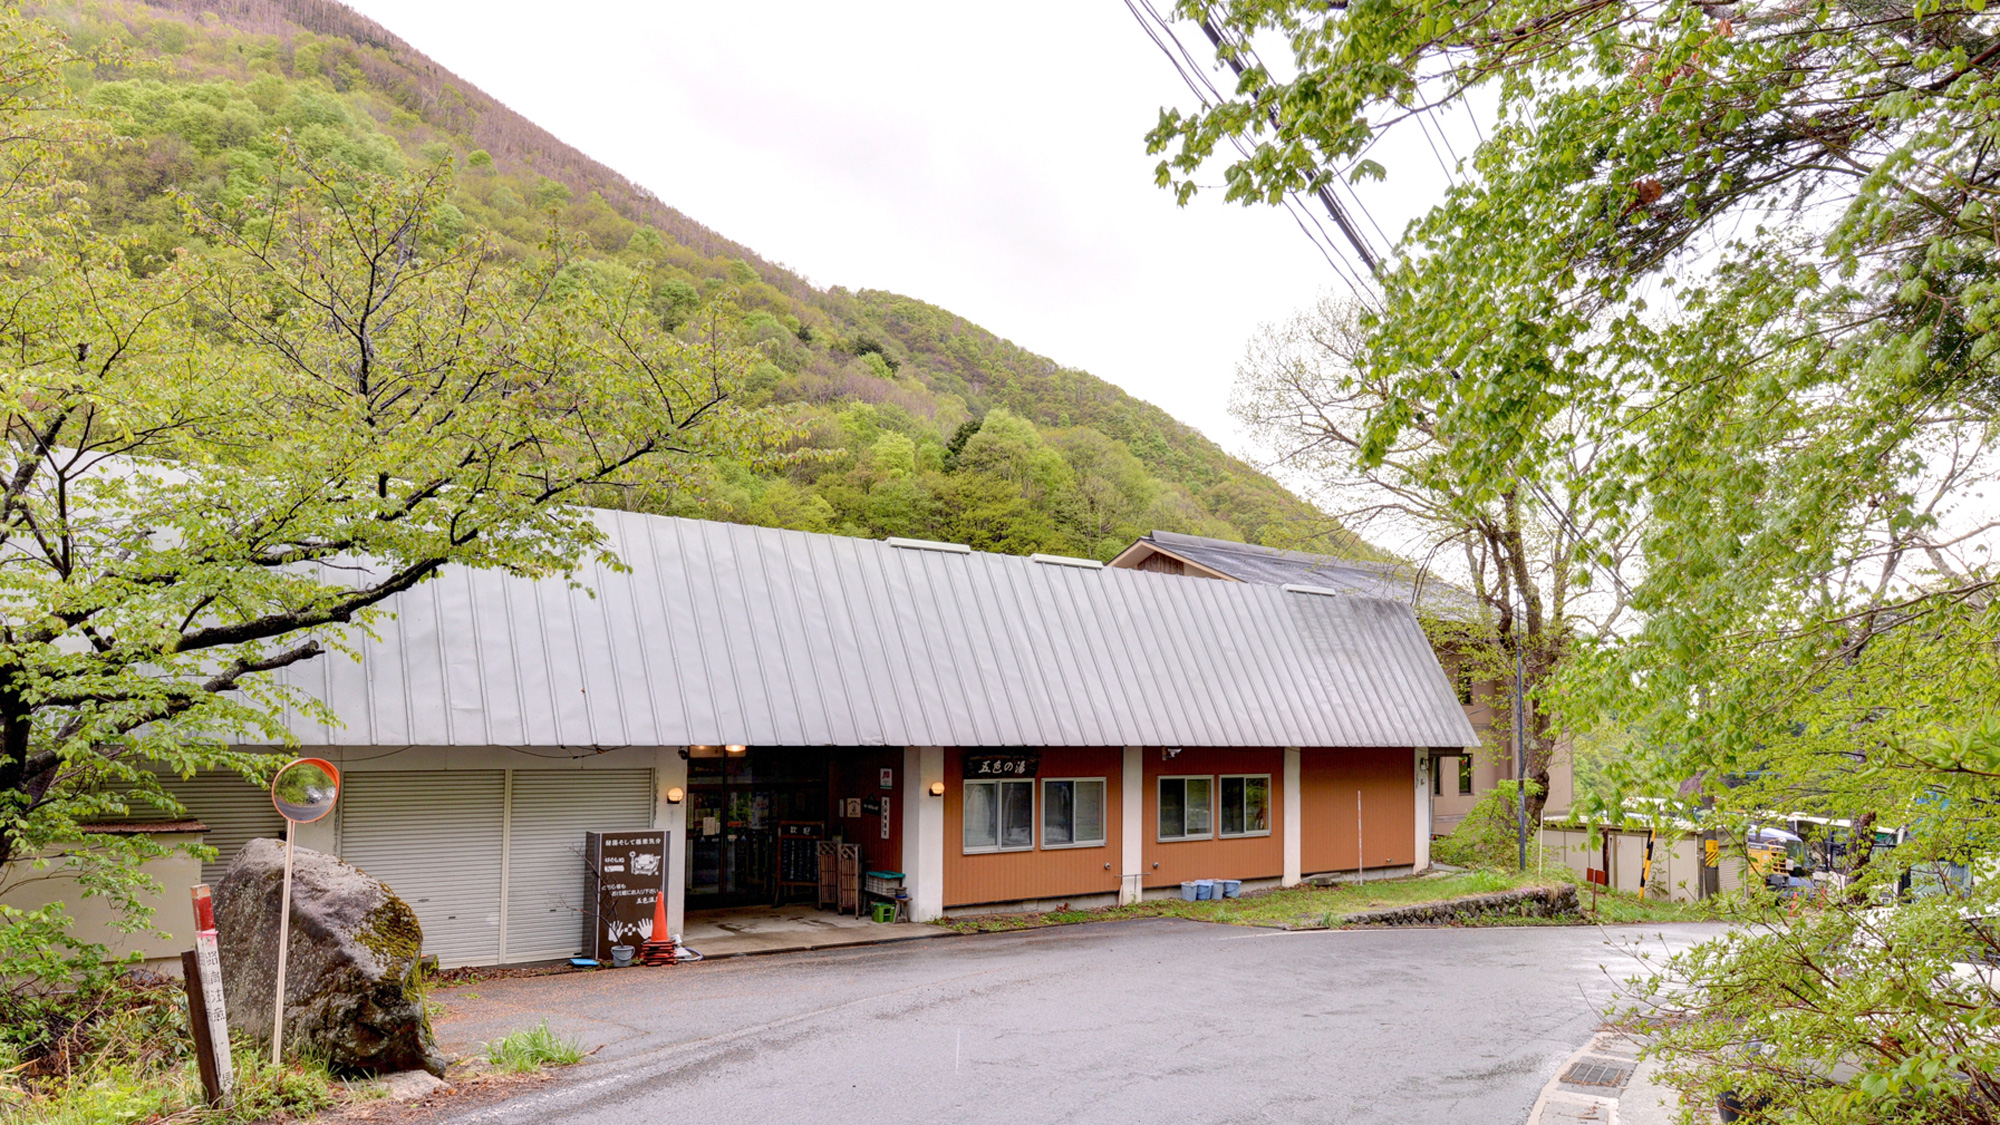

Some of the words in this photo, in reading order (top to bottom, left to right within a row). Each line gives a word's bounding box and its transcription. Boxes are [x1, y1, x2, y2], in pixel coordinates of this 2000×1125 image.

[978, 760, 1026, 774] 五色の湯
[636, 896, 658, 904] 五色温
